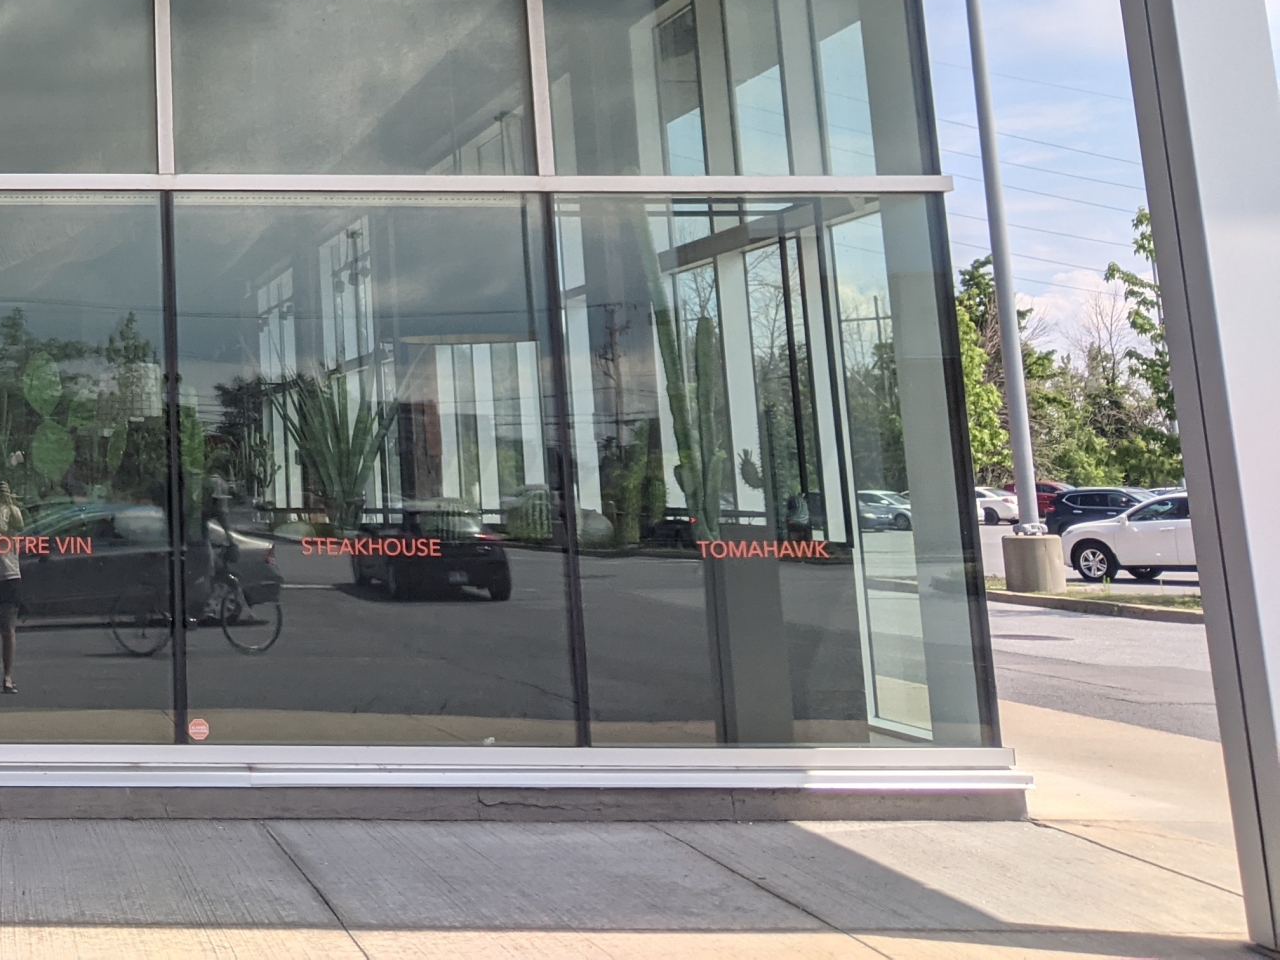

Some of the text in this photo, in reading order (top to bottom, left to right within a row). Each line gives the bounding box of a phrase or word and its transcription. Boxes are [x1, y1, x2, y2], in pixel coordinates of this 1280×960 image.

[55, 538, 93, 555] VIN
[301, 538, 442, 557] STEAKHOUSE
[697, 541, 830, 558] TOMAHAWK
